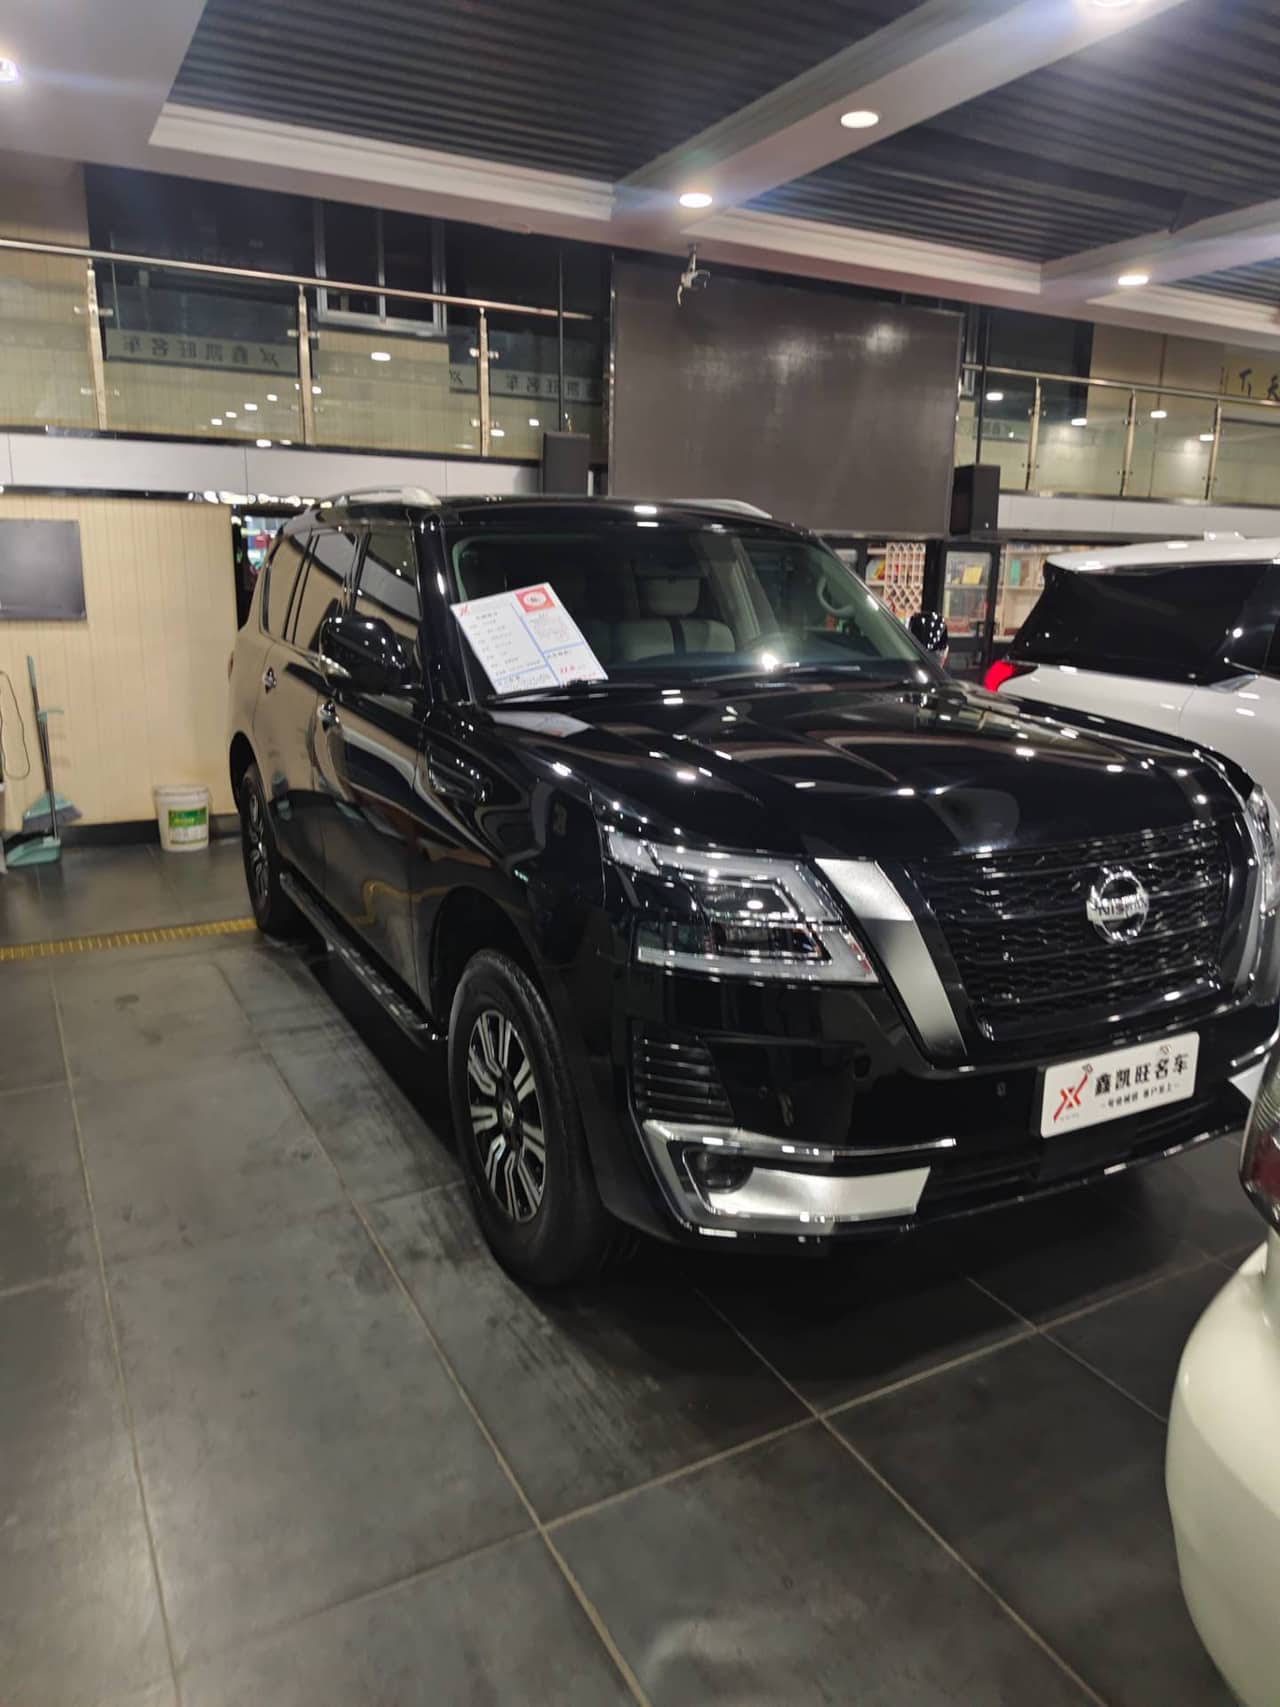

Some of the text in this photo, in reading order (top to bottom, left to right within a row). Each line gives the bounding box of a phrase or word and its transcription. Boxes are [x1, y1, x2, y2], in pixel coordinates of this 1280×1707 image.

[1094, 1053, 1189, 1096] 鑫凯旺名车
